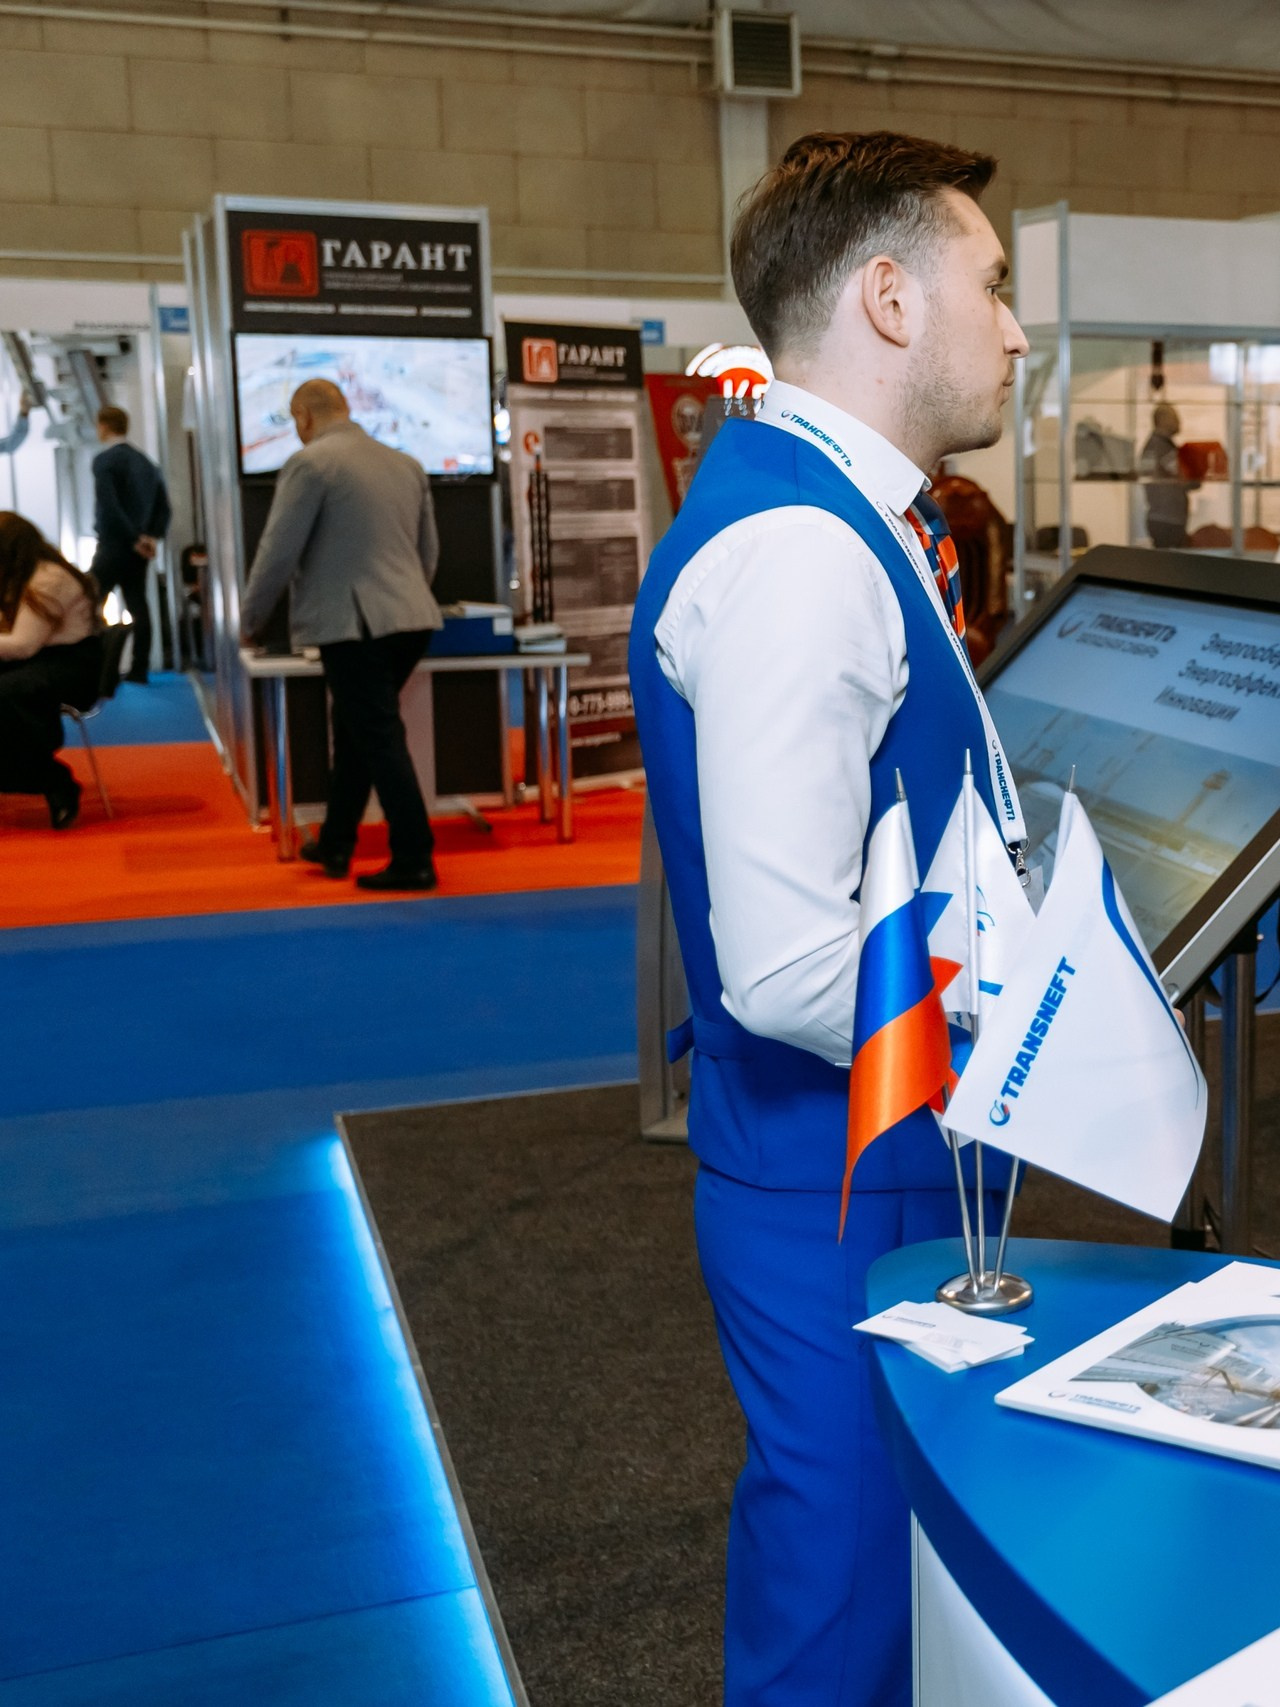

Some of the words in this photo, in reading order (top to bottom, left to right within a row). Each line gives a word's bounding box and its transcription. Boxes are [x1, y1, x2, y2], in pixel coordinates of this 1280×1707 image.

[321, 238, 472, 272] ГАРАНТ
[557, 342, 627, 367] ГАРАНТ
[789, 414, 852, 467] ТРАНСНЕФТЬ
[1000, 956, 1076, 1099] TRANSNEFT
